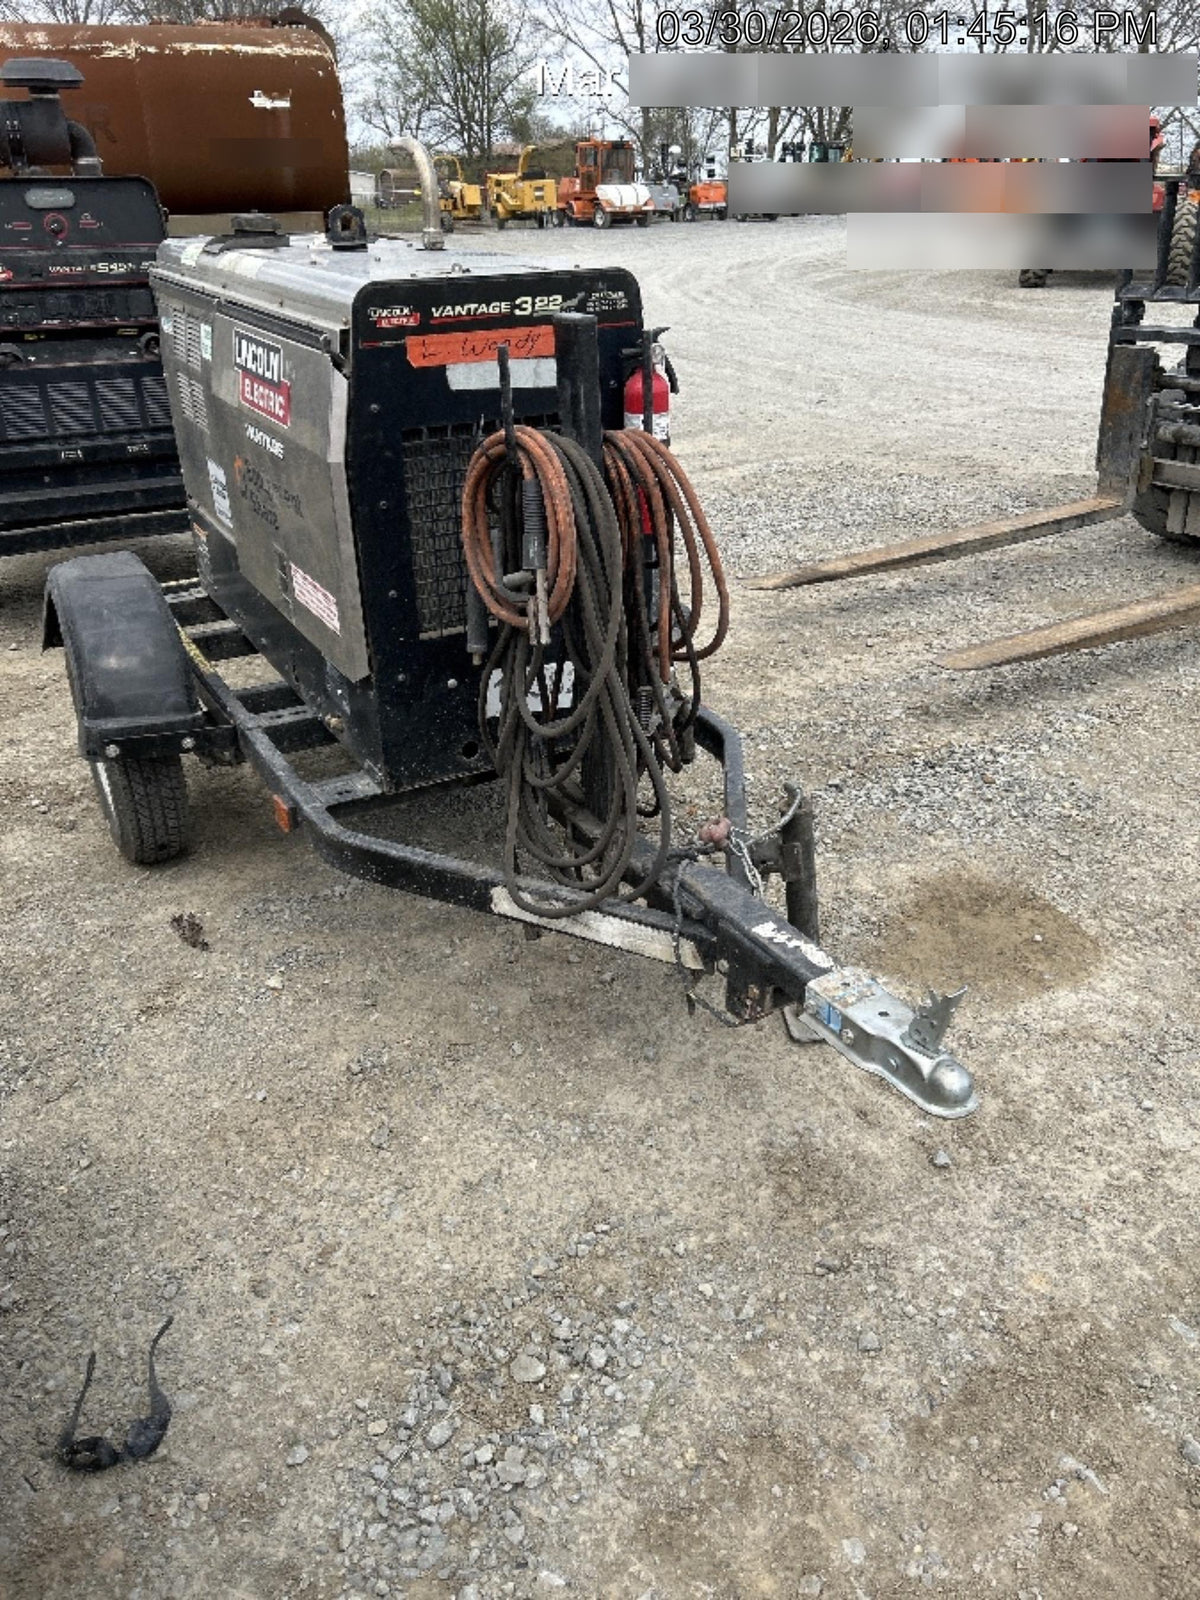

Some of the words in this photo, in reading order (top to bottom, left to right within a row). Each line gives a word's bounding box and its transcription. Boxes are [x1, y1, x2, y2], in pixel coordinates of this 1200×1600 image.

[431, 301, 512, 318] VANTAGE
[513, 294, 563, 316] 322
[235, 335, 281, 384] LINCOLN
[243, 377, 286, 419] ELECTRIC
